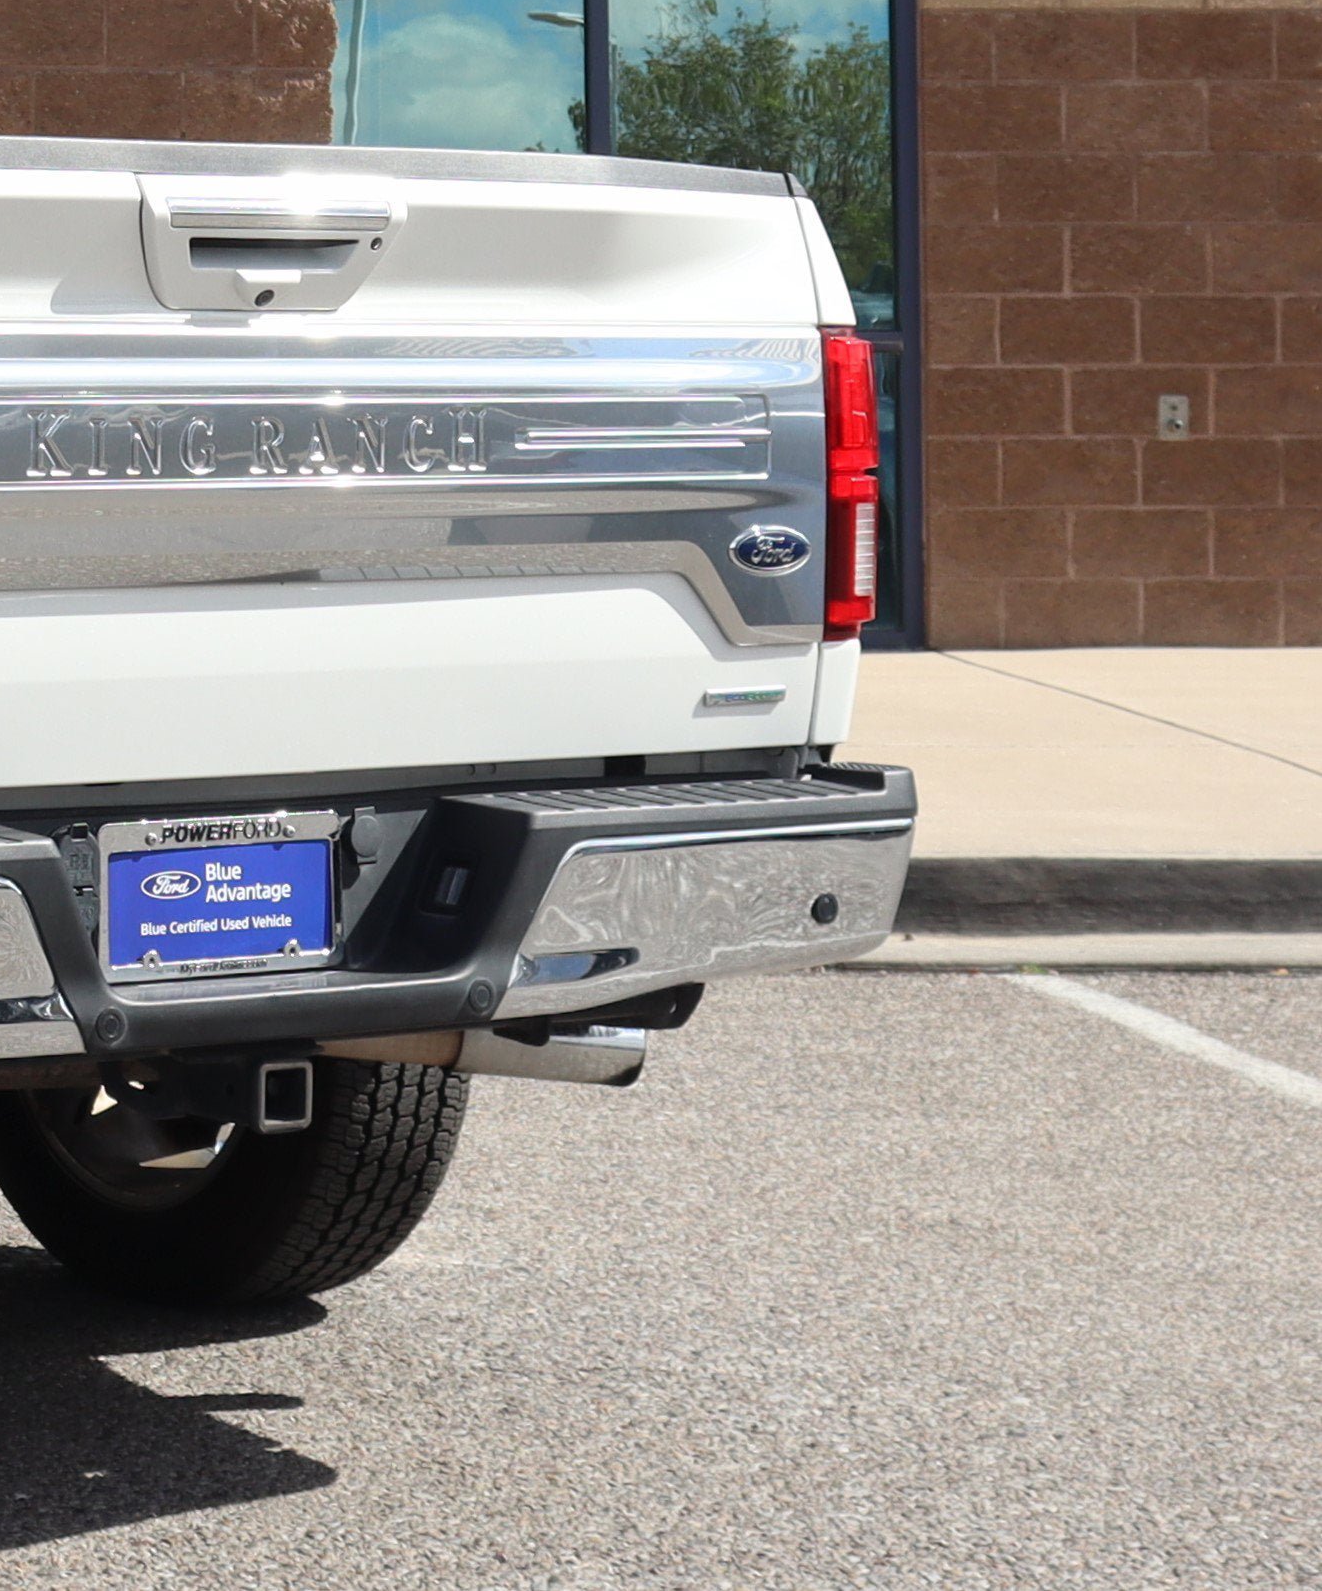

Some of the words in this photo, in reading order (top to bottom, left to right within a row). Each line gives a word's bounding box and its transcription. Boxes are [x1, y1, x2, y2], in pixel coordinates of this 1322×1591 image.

[24, 410, 218, 478] KING
[247, 407, 491, 477] RANCH
[751, 534, 797, 565] Ford
[205, 863, 242, 881] Blue
[152, 875, 191, 895] Ford
[205, 881, 292, 903] Advantage
[140, 921, 167, 936] Blue
[169, 917, 218, 935] Certified
[220, 915, 250, 931] Used
[252, 912, 292, 928] Vehicle
